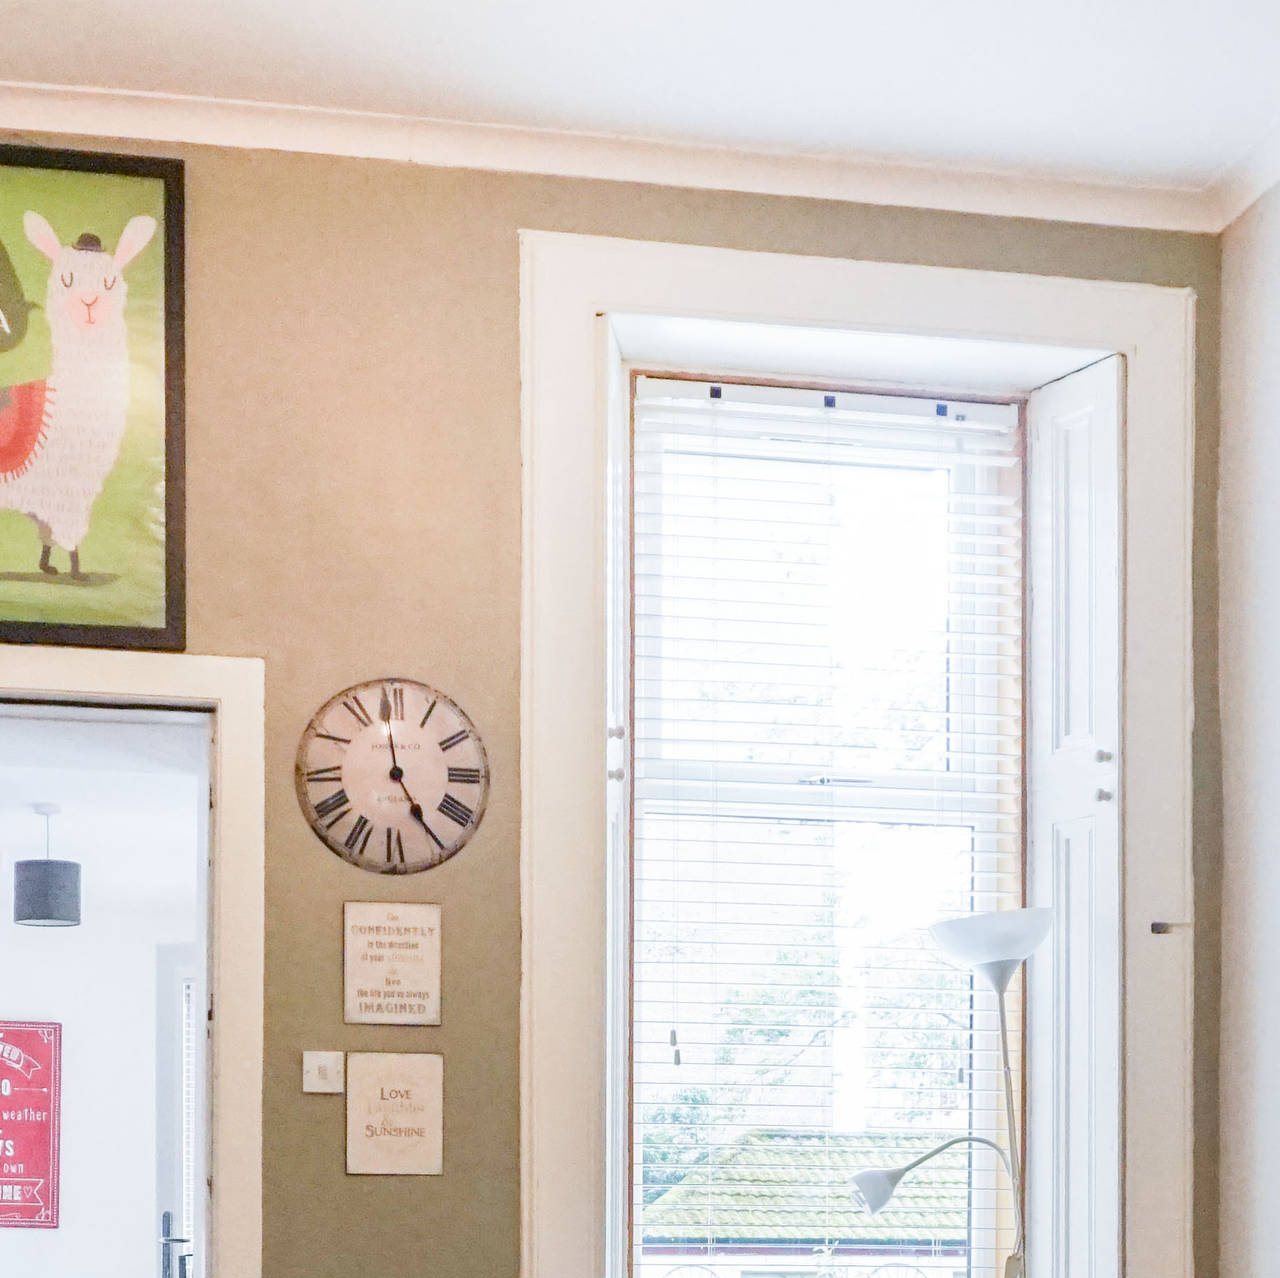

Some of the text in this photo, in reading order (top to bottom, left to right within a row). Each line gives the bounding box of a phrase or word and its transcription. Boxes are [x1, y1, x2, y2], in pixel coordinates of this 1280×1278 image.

[350, 924, 437, 937] CONFIDENTLY
[358, 1001, 427, 1015] IMAGINED
[380, 1086, 414, 1101] LOVE
[2, 1108, 48, 1122] weather
[3, 1162, 24, 1174] own
